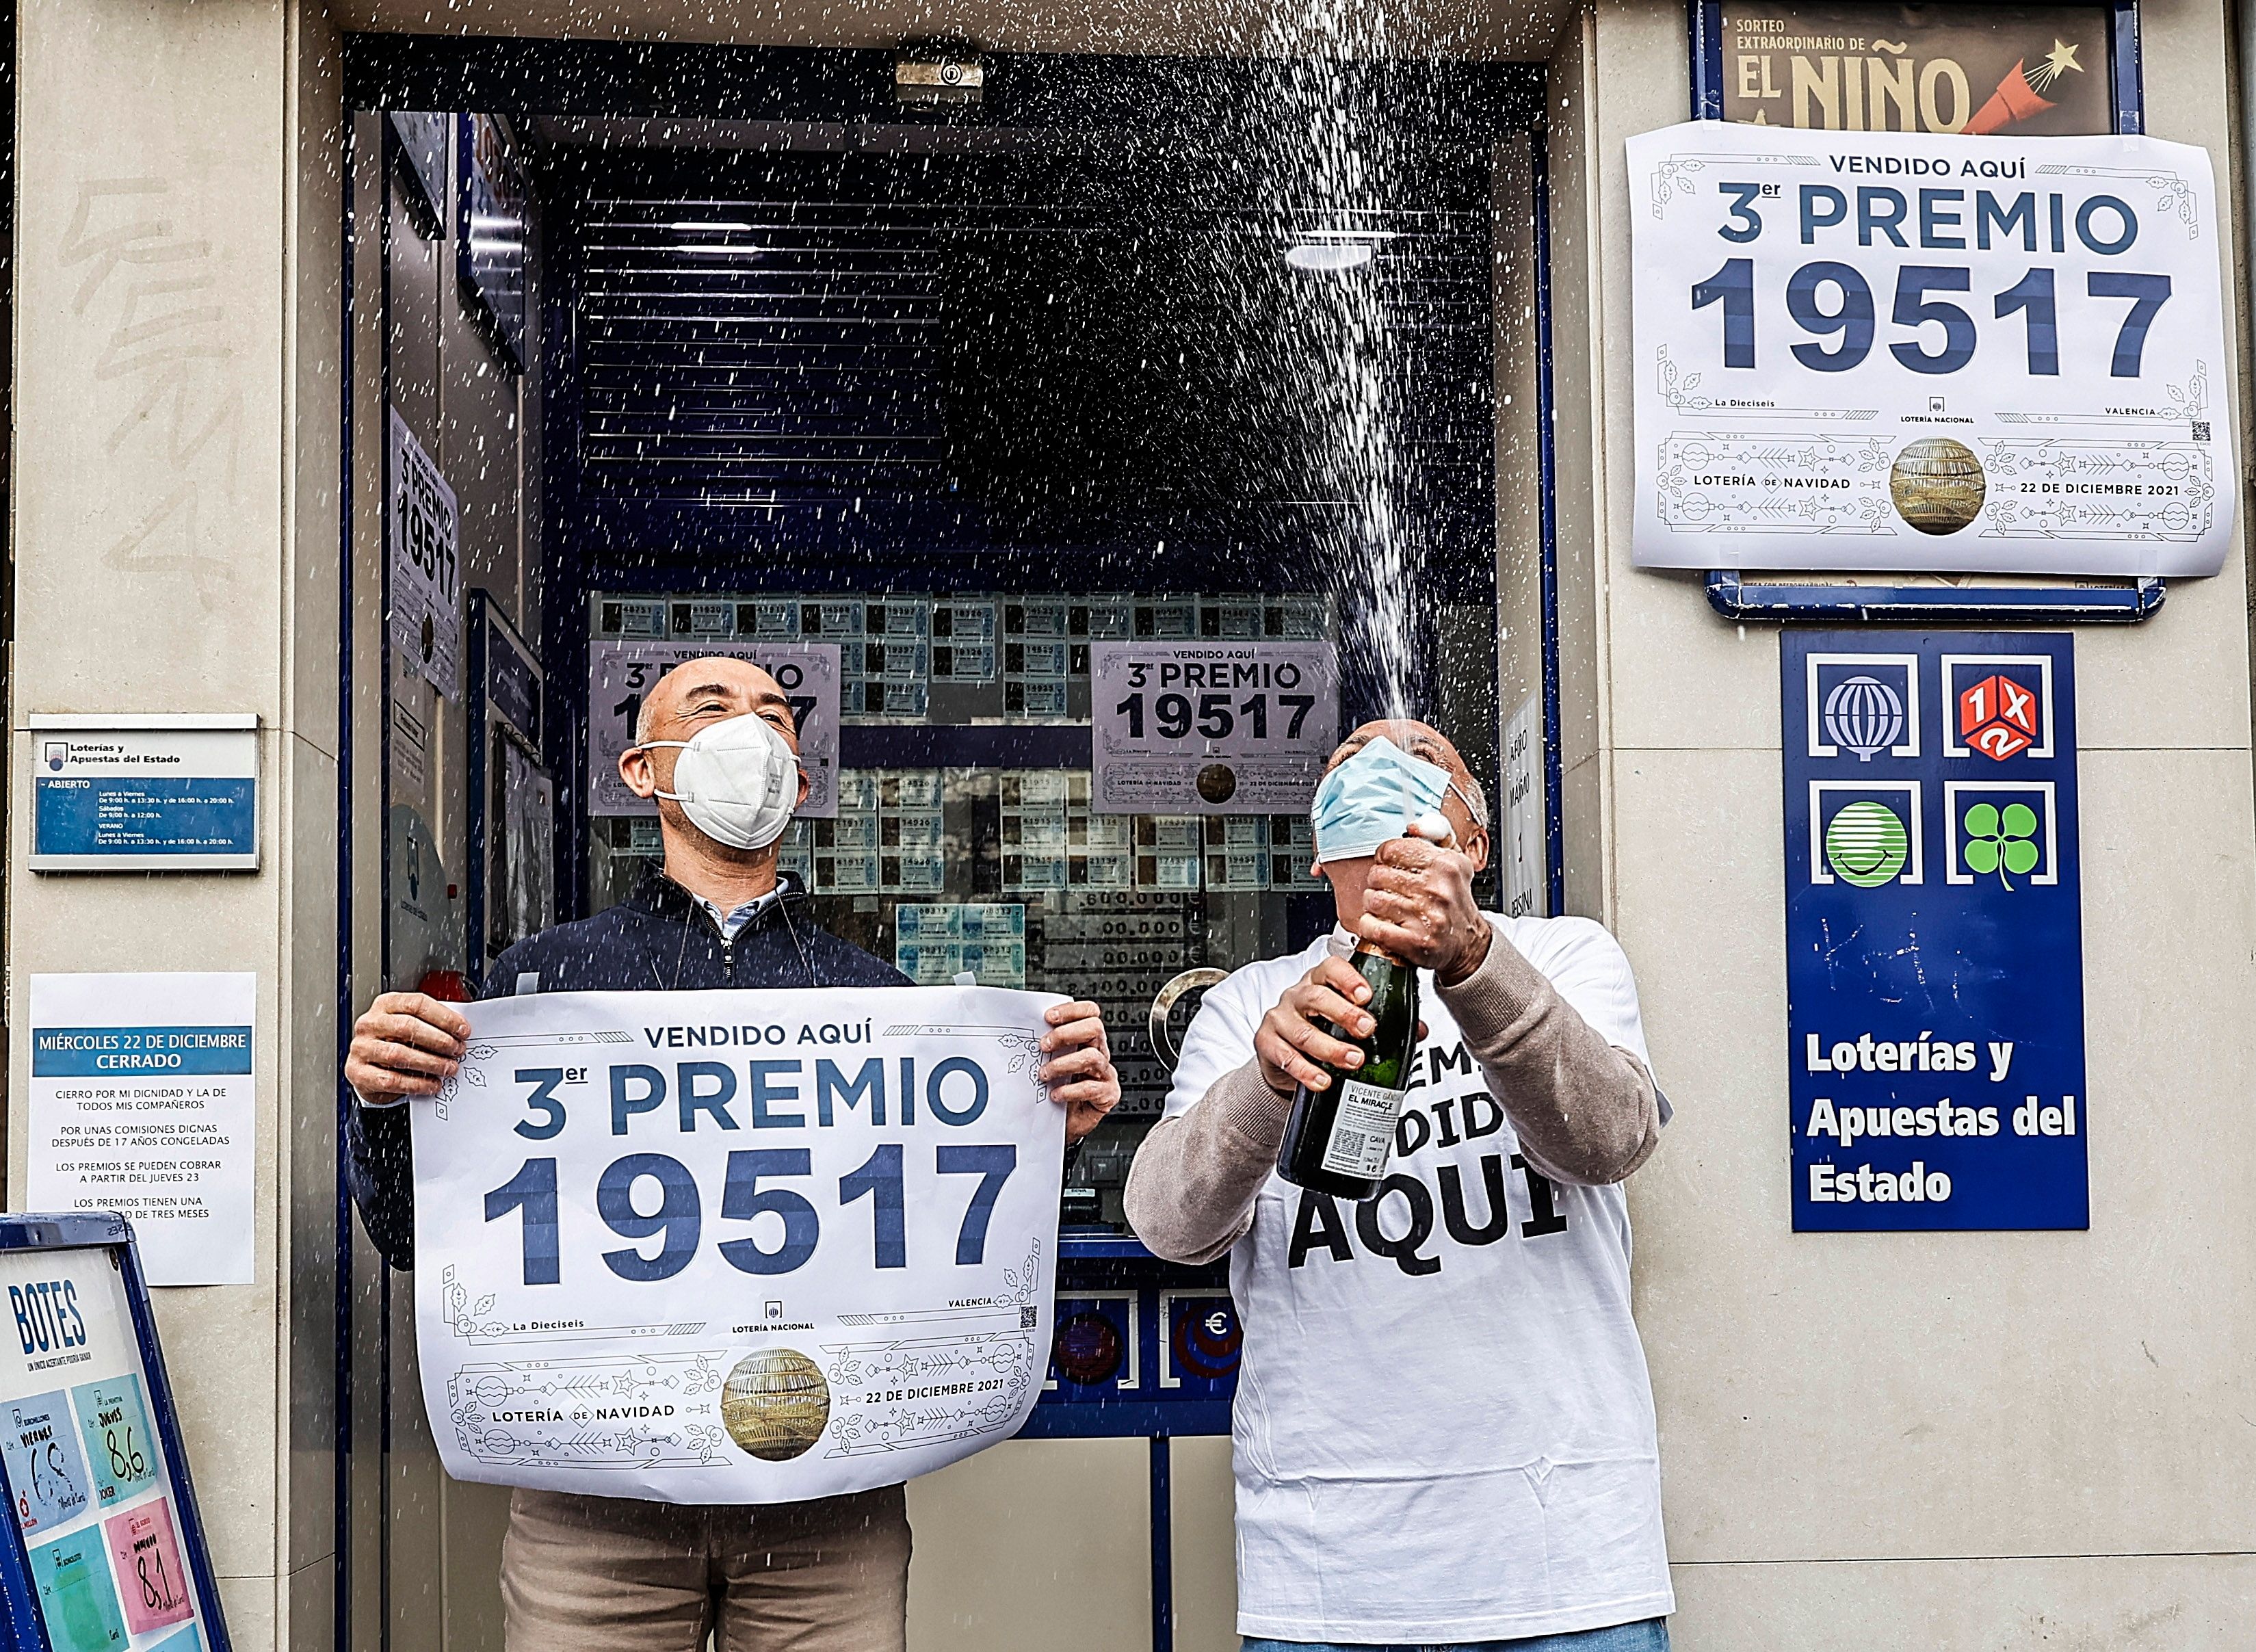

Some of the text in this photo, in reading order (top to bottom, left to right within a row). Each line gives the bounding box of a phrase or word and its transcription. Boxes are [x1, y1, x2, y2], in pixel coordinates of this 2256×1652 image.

[1737, 19, 1784, 32] SORTEO
[1737, 35, 1865, 52] EXTRAORDINARIO DE
[1737, 39, 1970, 135] EL NIÑO
[1830, 155, 2025, 179] VENDIDO AQUÍ
[1800, 185, 2138, 255] PREMIO
[1692, 258, 2171, 380] 19517
[1695, 474, 1755, 486] LOTERÍA
[1785, 478, 1850, 488] NAVIDAD
[2021, 483, 2177, 495] 22 DE DICIEMBRE 2021
[412, 460, 451, 541] PREMIO
[398, 490, 456, 605] 19517
[674, 650, 757, 659] VENDIDO AQUÍ
[1173, 648, 1255, 659] VENDIDO AQUÍ
[1161, 662, 1300, 689] PREMIO
[1116, 693, 1315, 739] 19517
[1969, 684, 2030, 757] 1 X 2
[70, 744, 124, 754] Loterías y
[70, 755, 120, 764] Apuestas
[124, 755, 140, 763] del
[48, 780, 90, 789] ABIERTO
[1518, 832, 1523, 863] 1
[644, 1018, 871, 1048] VENDIDO AQUÍ
[40, 1033, 246, 1049] MIÉRCOLES 22 DE DICIEMBRE
[96, 1054, 181, 1068] CERRADO
[1807, 1031, 2013, 1081] Loterías y
[56, 1090, 92, 1099] CIERRO
[134, 1089, 183, 1097] DIGNIDAD
[213, 1088, 226, 1097] DE
[609, 1057, 988, 1136] PREMIO
[1348, 1094, 1359, 1103] EL
[1351, 1086, 1380, 1099] VICENTE
[136, 1100, 204, 1110] COMPAÑEROS
[1807, 1095, 2075, 1147] Apuestas del
[115, 1125, 174, 1134] COMISIONES
[179, 1125, 217, 1133] DIGNAS
[52, 1138, 94, 1146] DESPUÉS
[131, 1136, 157, 1145] AÑOS
[161, 1137, 229, 1145] CONGELADAS
[139, 1162, 176, 1170] PUEDEN
[180, 1161, 221, 1169] COBRAR
[150, 1174, 183, 1183] JUEVES
[187, 1173, 198, 1181] 23
[1809, 1162, 1951, 1203] Estado
[97, 1198, 139, 1207] PREMIOS
[143, 1198, 176, 1206] TIENEN
[178, 1209, 209, 1218] MESES
[484, 1144, 1018, 1287] 19517
[949, 1298, 993, 1309] VALENCIA
[8, 1279, 87, 1355] BOTES
[532, 1320, 585, 1330] Dieciseis
[733, 1324, 768, 1333] LOTERÍA
[867, 1379, 1003, 1403] 22 DE DICIEMBRE 2021
[98, 1406, 122, 1428] JUEVES
[493, 1406, 674, 1421] LOTERÍA DE NAVIDAD
